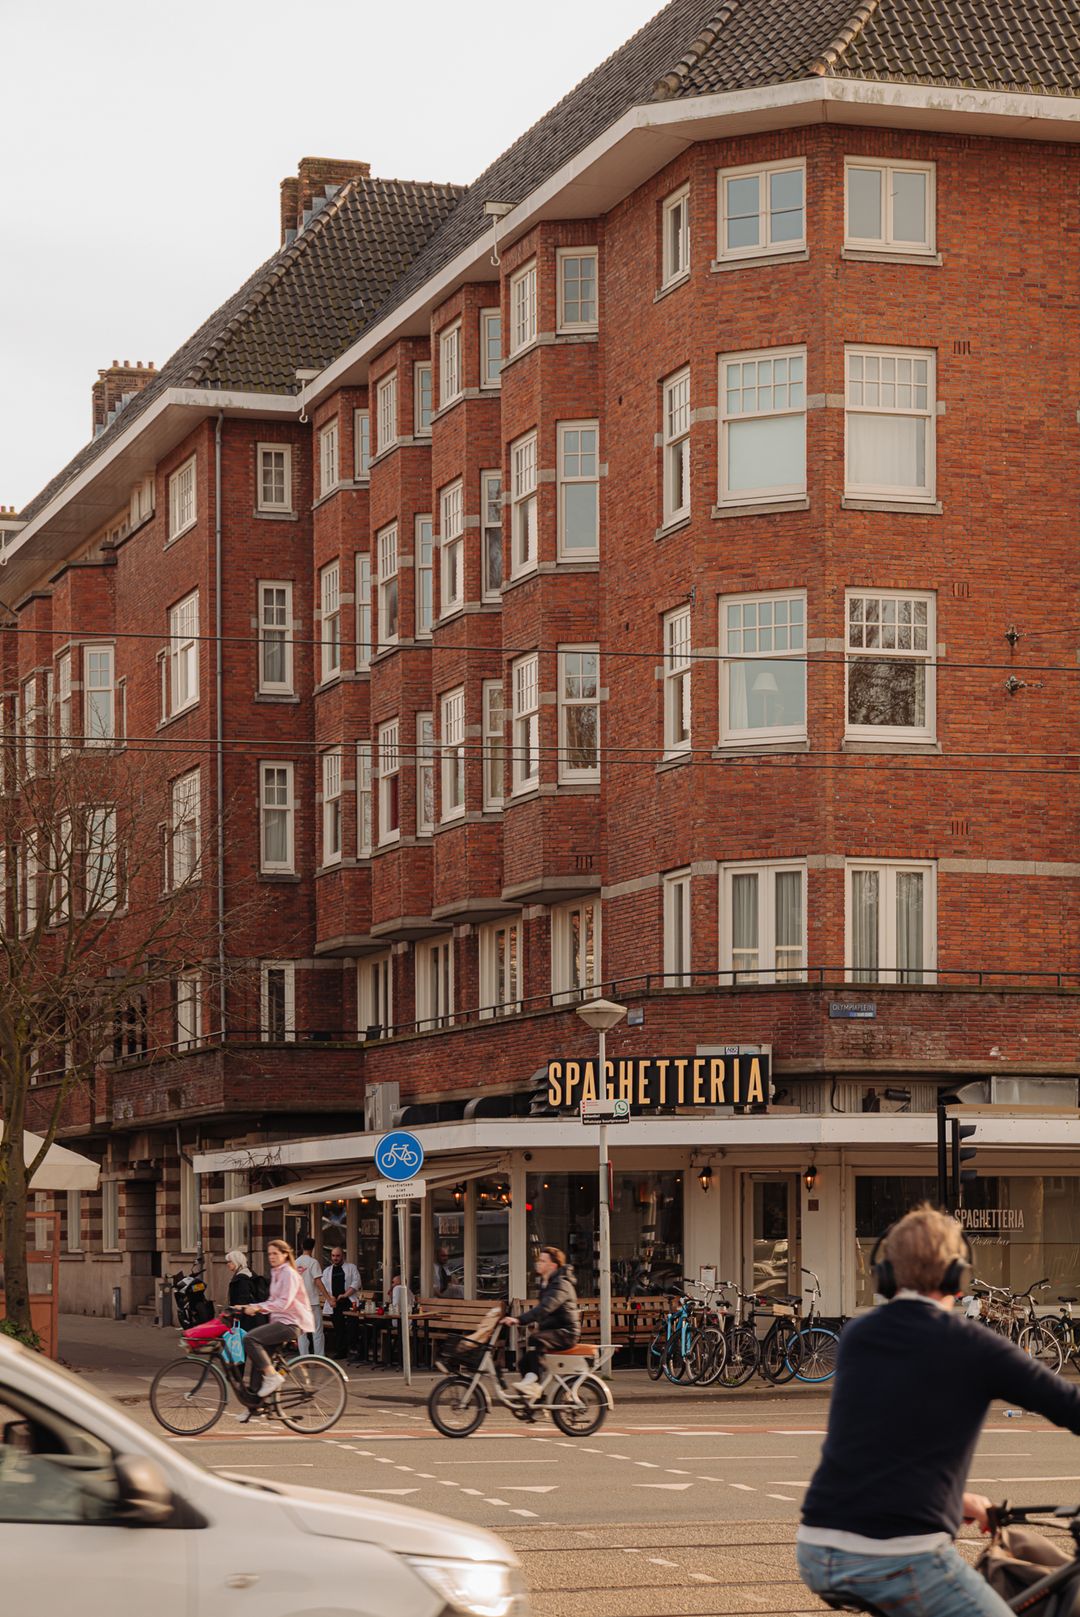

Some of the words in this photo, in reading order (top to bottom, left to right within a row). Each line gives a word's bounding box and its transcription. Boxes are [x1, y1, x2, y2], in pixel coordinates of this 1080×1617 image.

[832, 1003, 874, 1011] OLYMPIAPLEIN
[548, 1057, 764, 1107] SPAGHETTERIA
[954, 1209, 1024, 1228] SPAGHETTERIA
